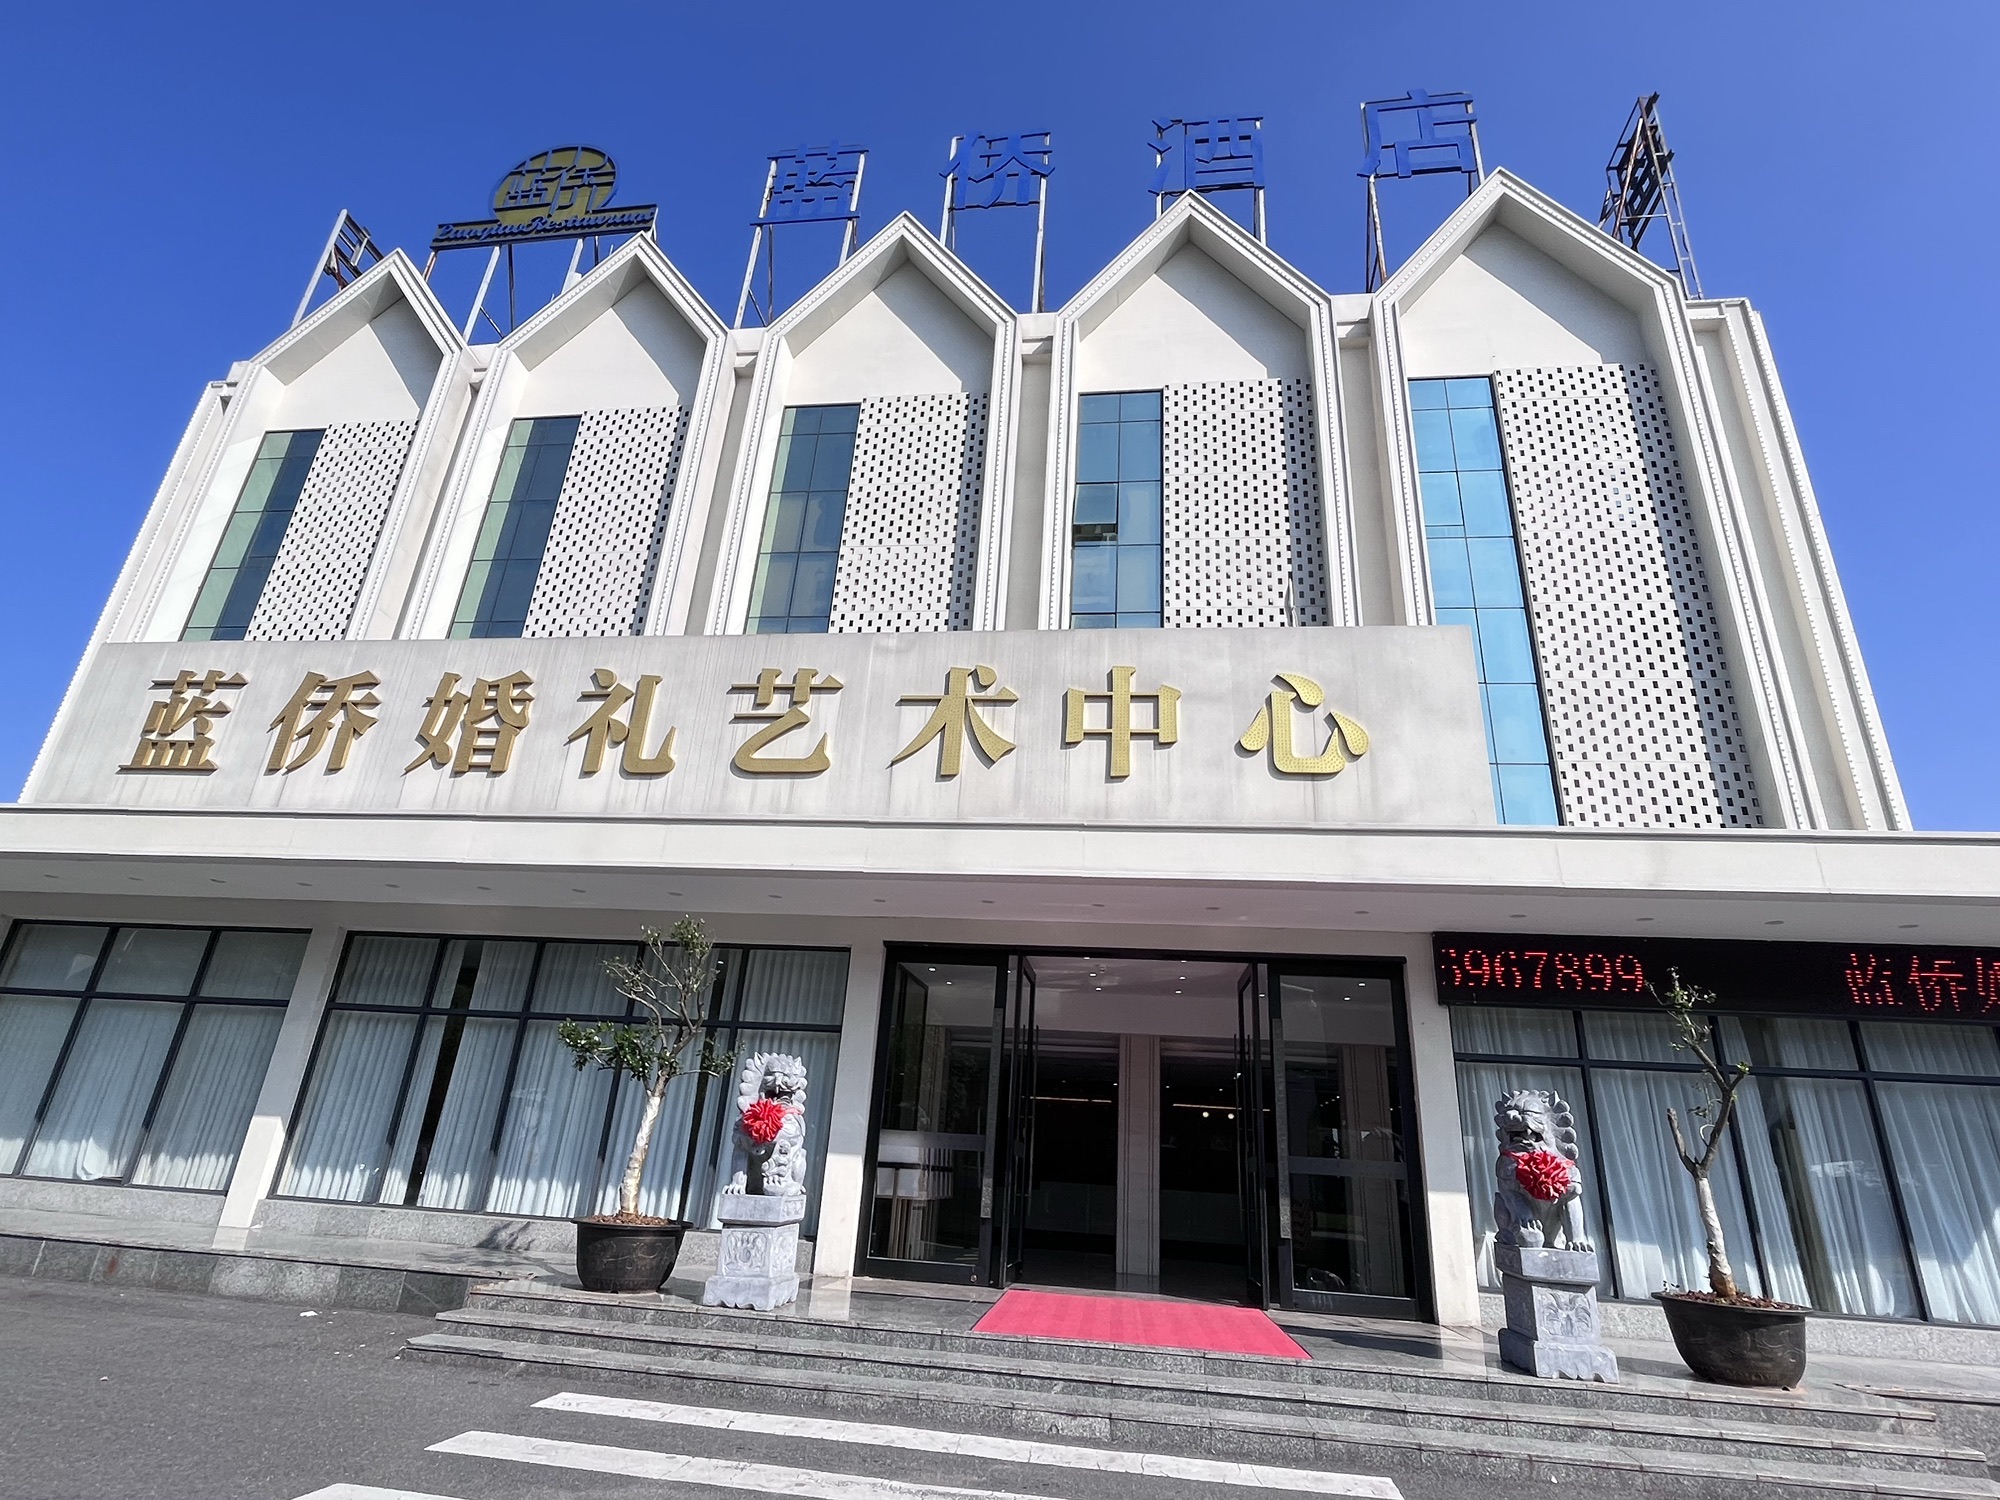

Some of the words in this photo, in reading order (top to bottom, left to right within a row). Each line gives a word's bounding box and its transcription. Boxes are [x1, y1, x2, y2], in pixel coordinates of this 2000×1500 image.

[750, 88, 1477, 226] 蓝侨酒店
[527, 210, 656, 234] Restaurant
[117, 665, 1371, 777] 蓝侨婚礼艺术中心
